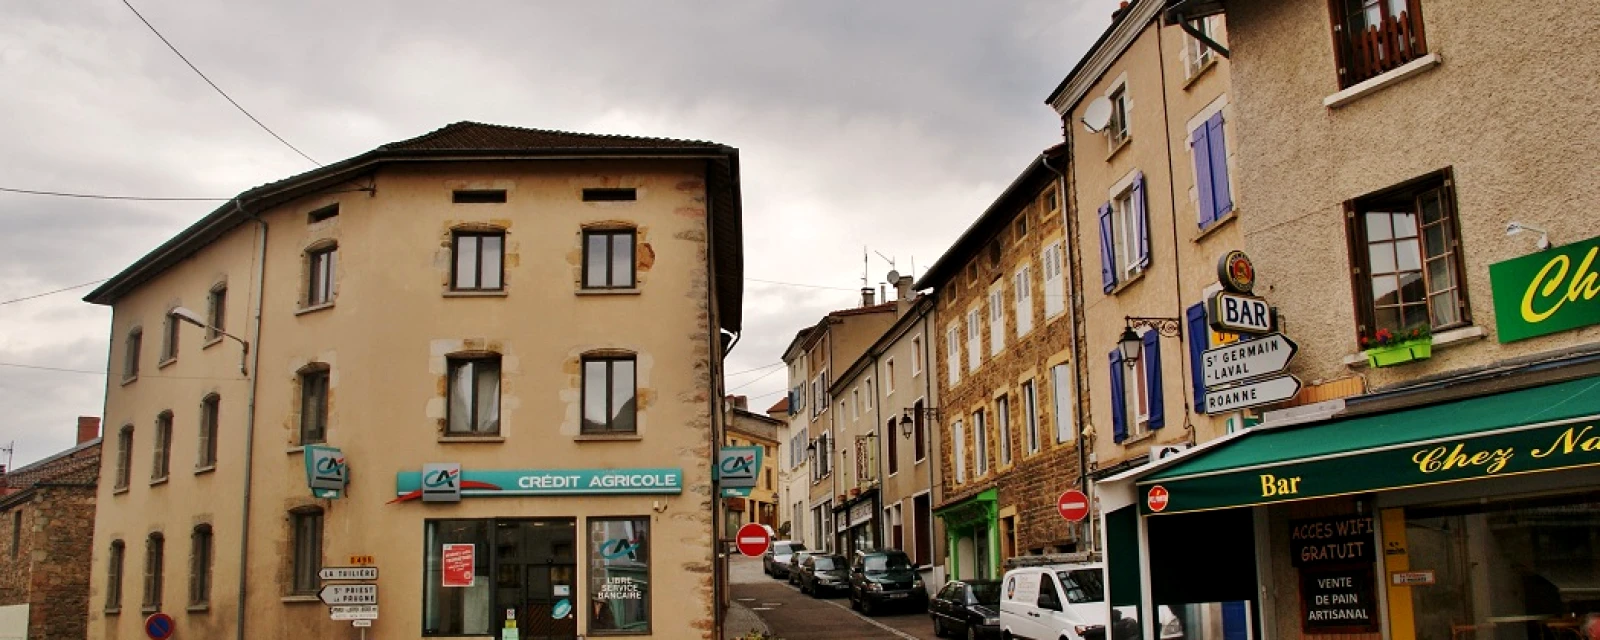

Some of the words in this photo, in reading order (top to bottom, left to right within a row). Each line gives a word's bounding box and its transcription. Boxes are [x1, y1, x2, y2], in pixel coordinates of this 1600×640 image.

[1225, 297, 1268, 327] BAR
[1222, 340, 1279, 363] GERMAIN
[1214, 363, 1250, 380] LAVAL
[1209, 389, 1257, 409] ROANNE
[1412, 443, 1514, 474] Chez
[518, 474, 581, 489] CRÉDIT
[588, 474, 677, 488] AGRICOLE
[1259, 473, 1301, 497] Bar
[1292, 522, 1333, 540] ACCES
[1335, 517, 1374, 536] WIFI
[1301, 541, 1364, 562] GRATUIT
[601, 584, 638, 592] SERVICE
[1317, 577, 1353, 589] VENTE
[597, 591, 642, 600] BANCAIRE
[1315, 594, 1330, 606] DE
[1332, 593, 1358, 605] PAIN
[1308, 608, 1369, 621] ARTISANAL
